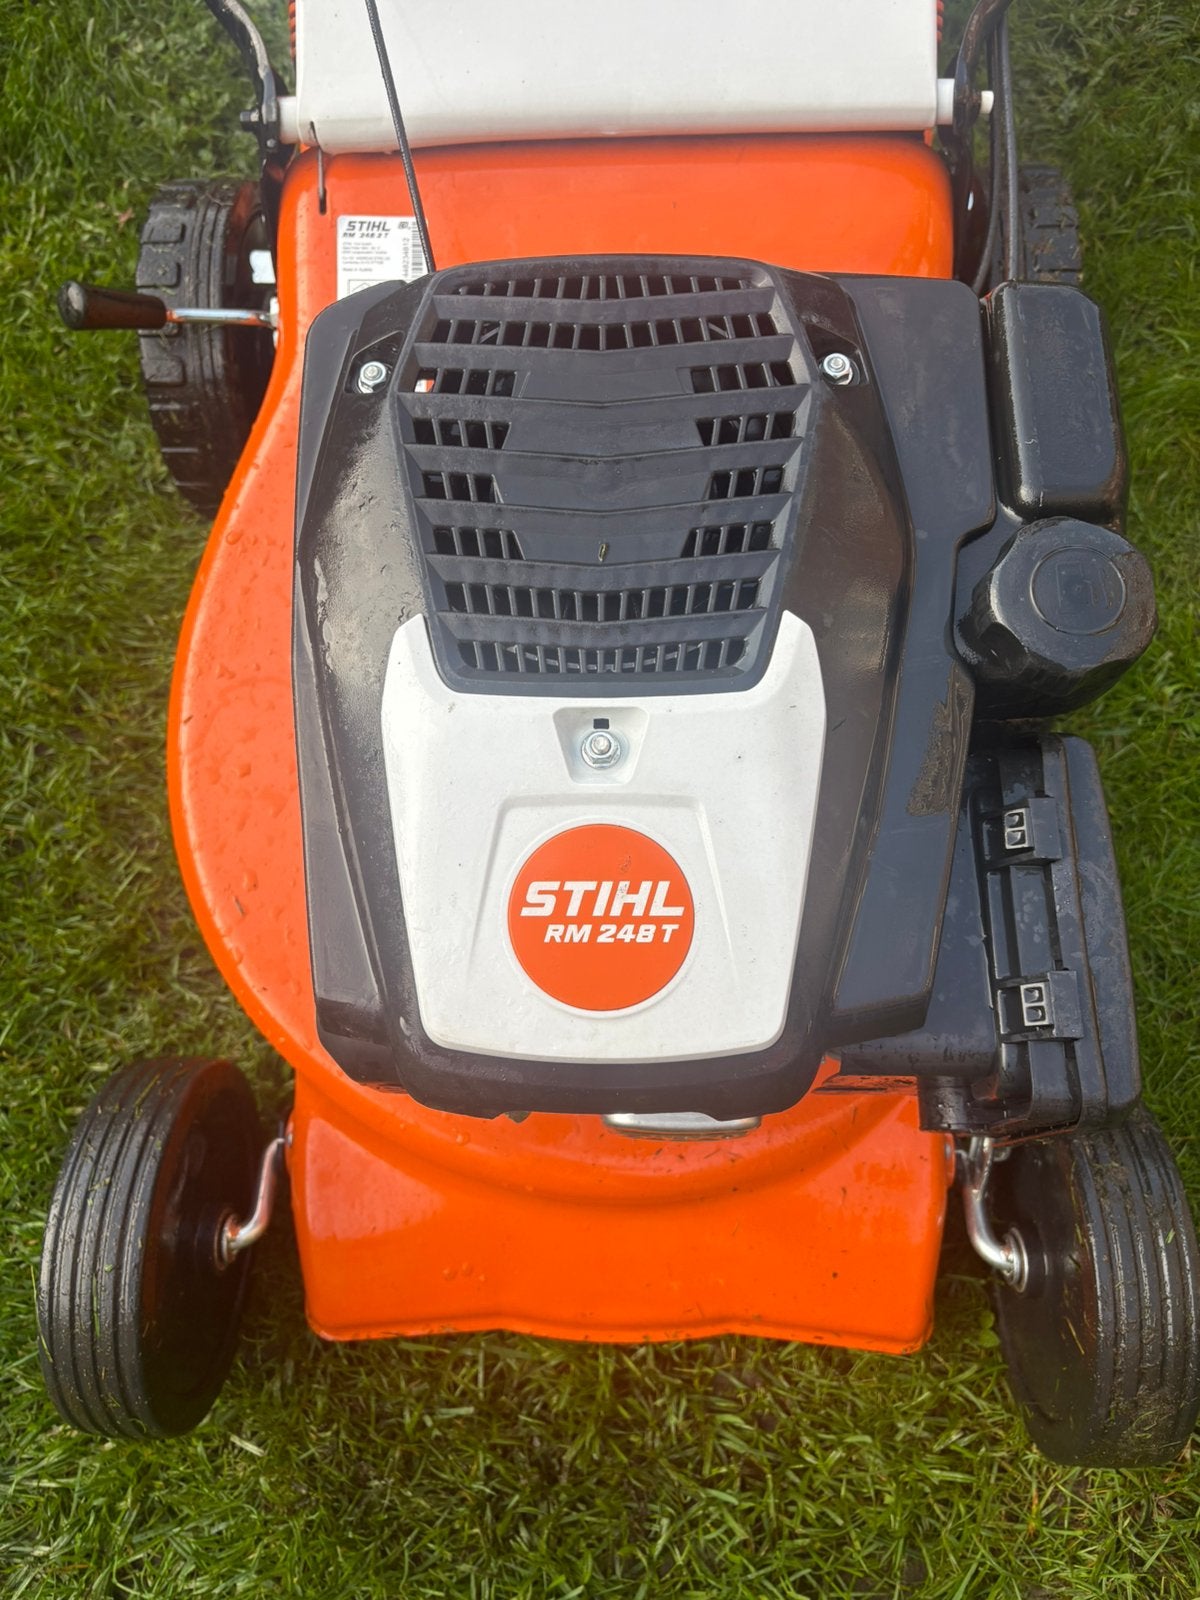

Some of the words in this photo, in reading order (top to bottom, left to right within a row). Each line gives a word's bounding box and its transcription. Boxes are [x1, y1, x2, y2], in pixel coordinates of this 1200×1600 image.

[346, 221, 391, 232] STIHL
[520, 880, 685, 917] STIHL
[543, 924, 592, 943] RM
[596, 924, 657, 943] 248
[661, 924, 680, 943] T
